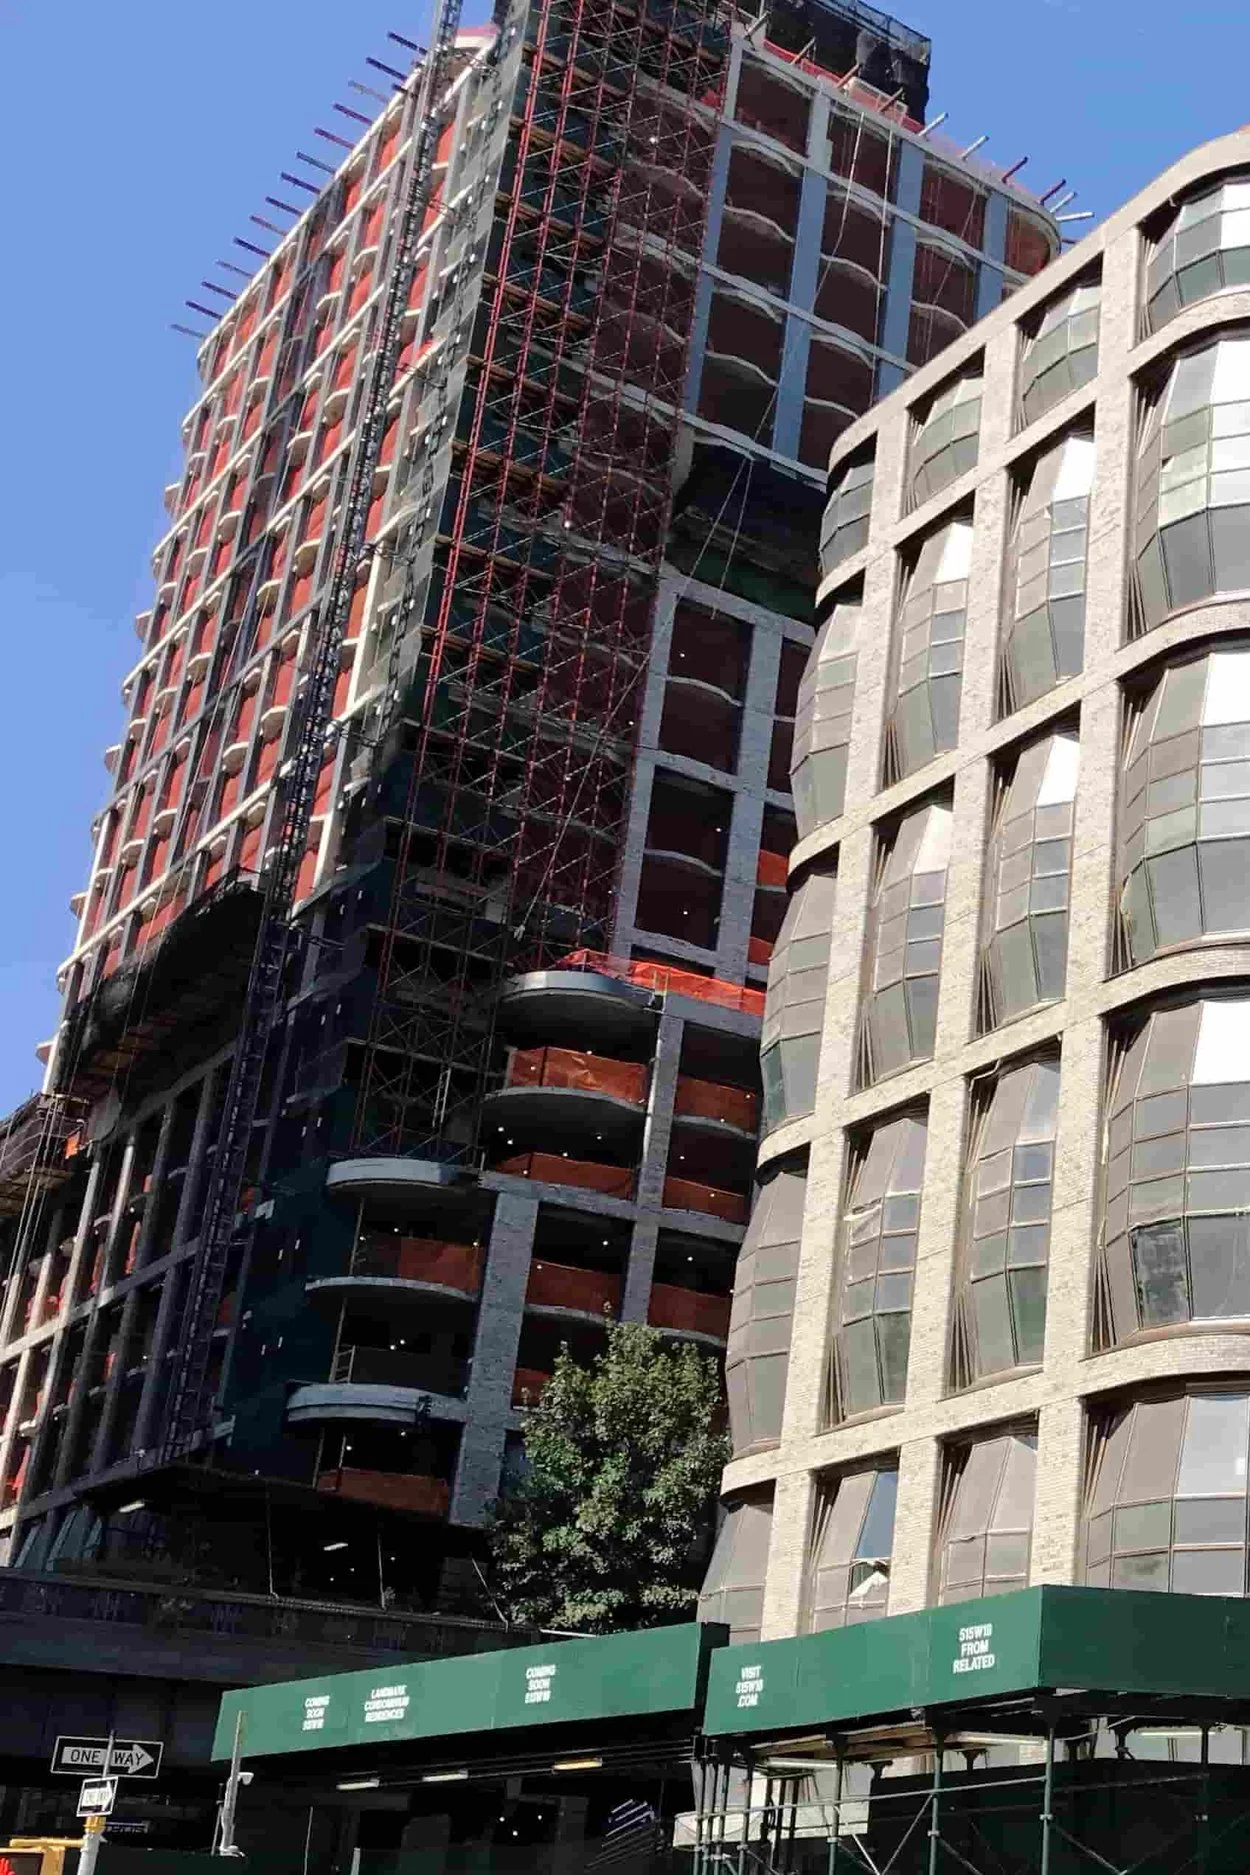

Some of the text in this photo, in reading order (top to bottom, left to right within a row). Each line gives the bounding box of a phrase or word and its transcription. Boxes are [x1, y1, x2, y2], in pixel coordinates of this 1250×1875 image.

[961, 1639, 989, 1657] FROM
[953, 1653, 995, 1674] RELATED
[70, 1749, 144, 1766] ONE WAY
